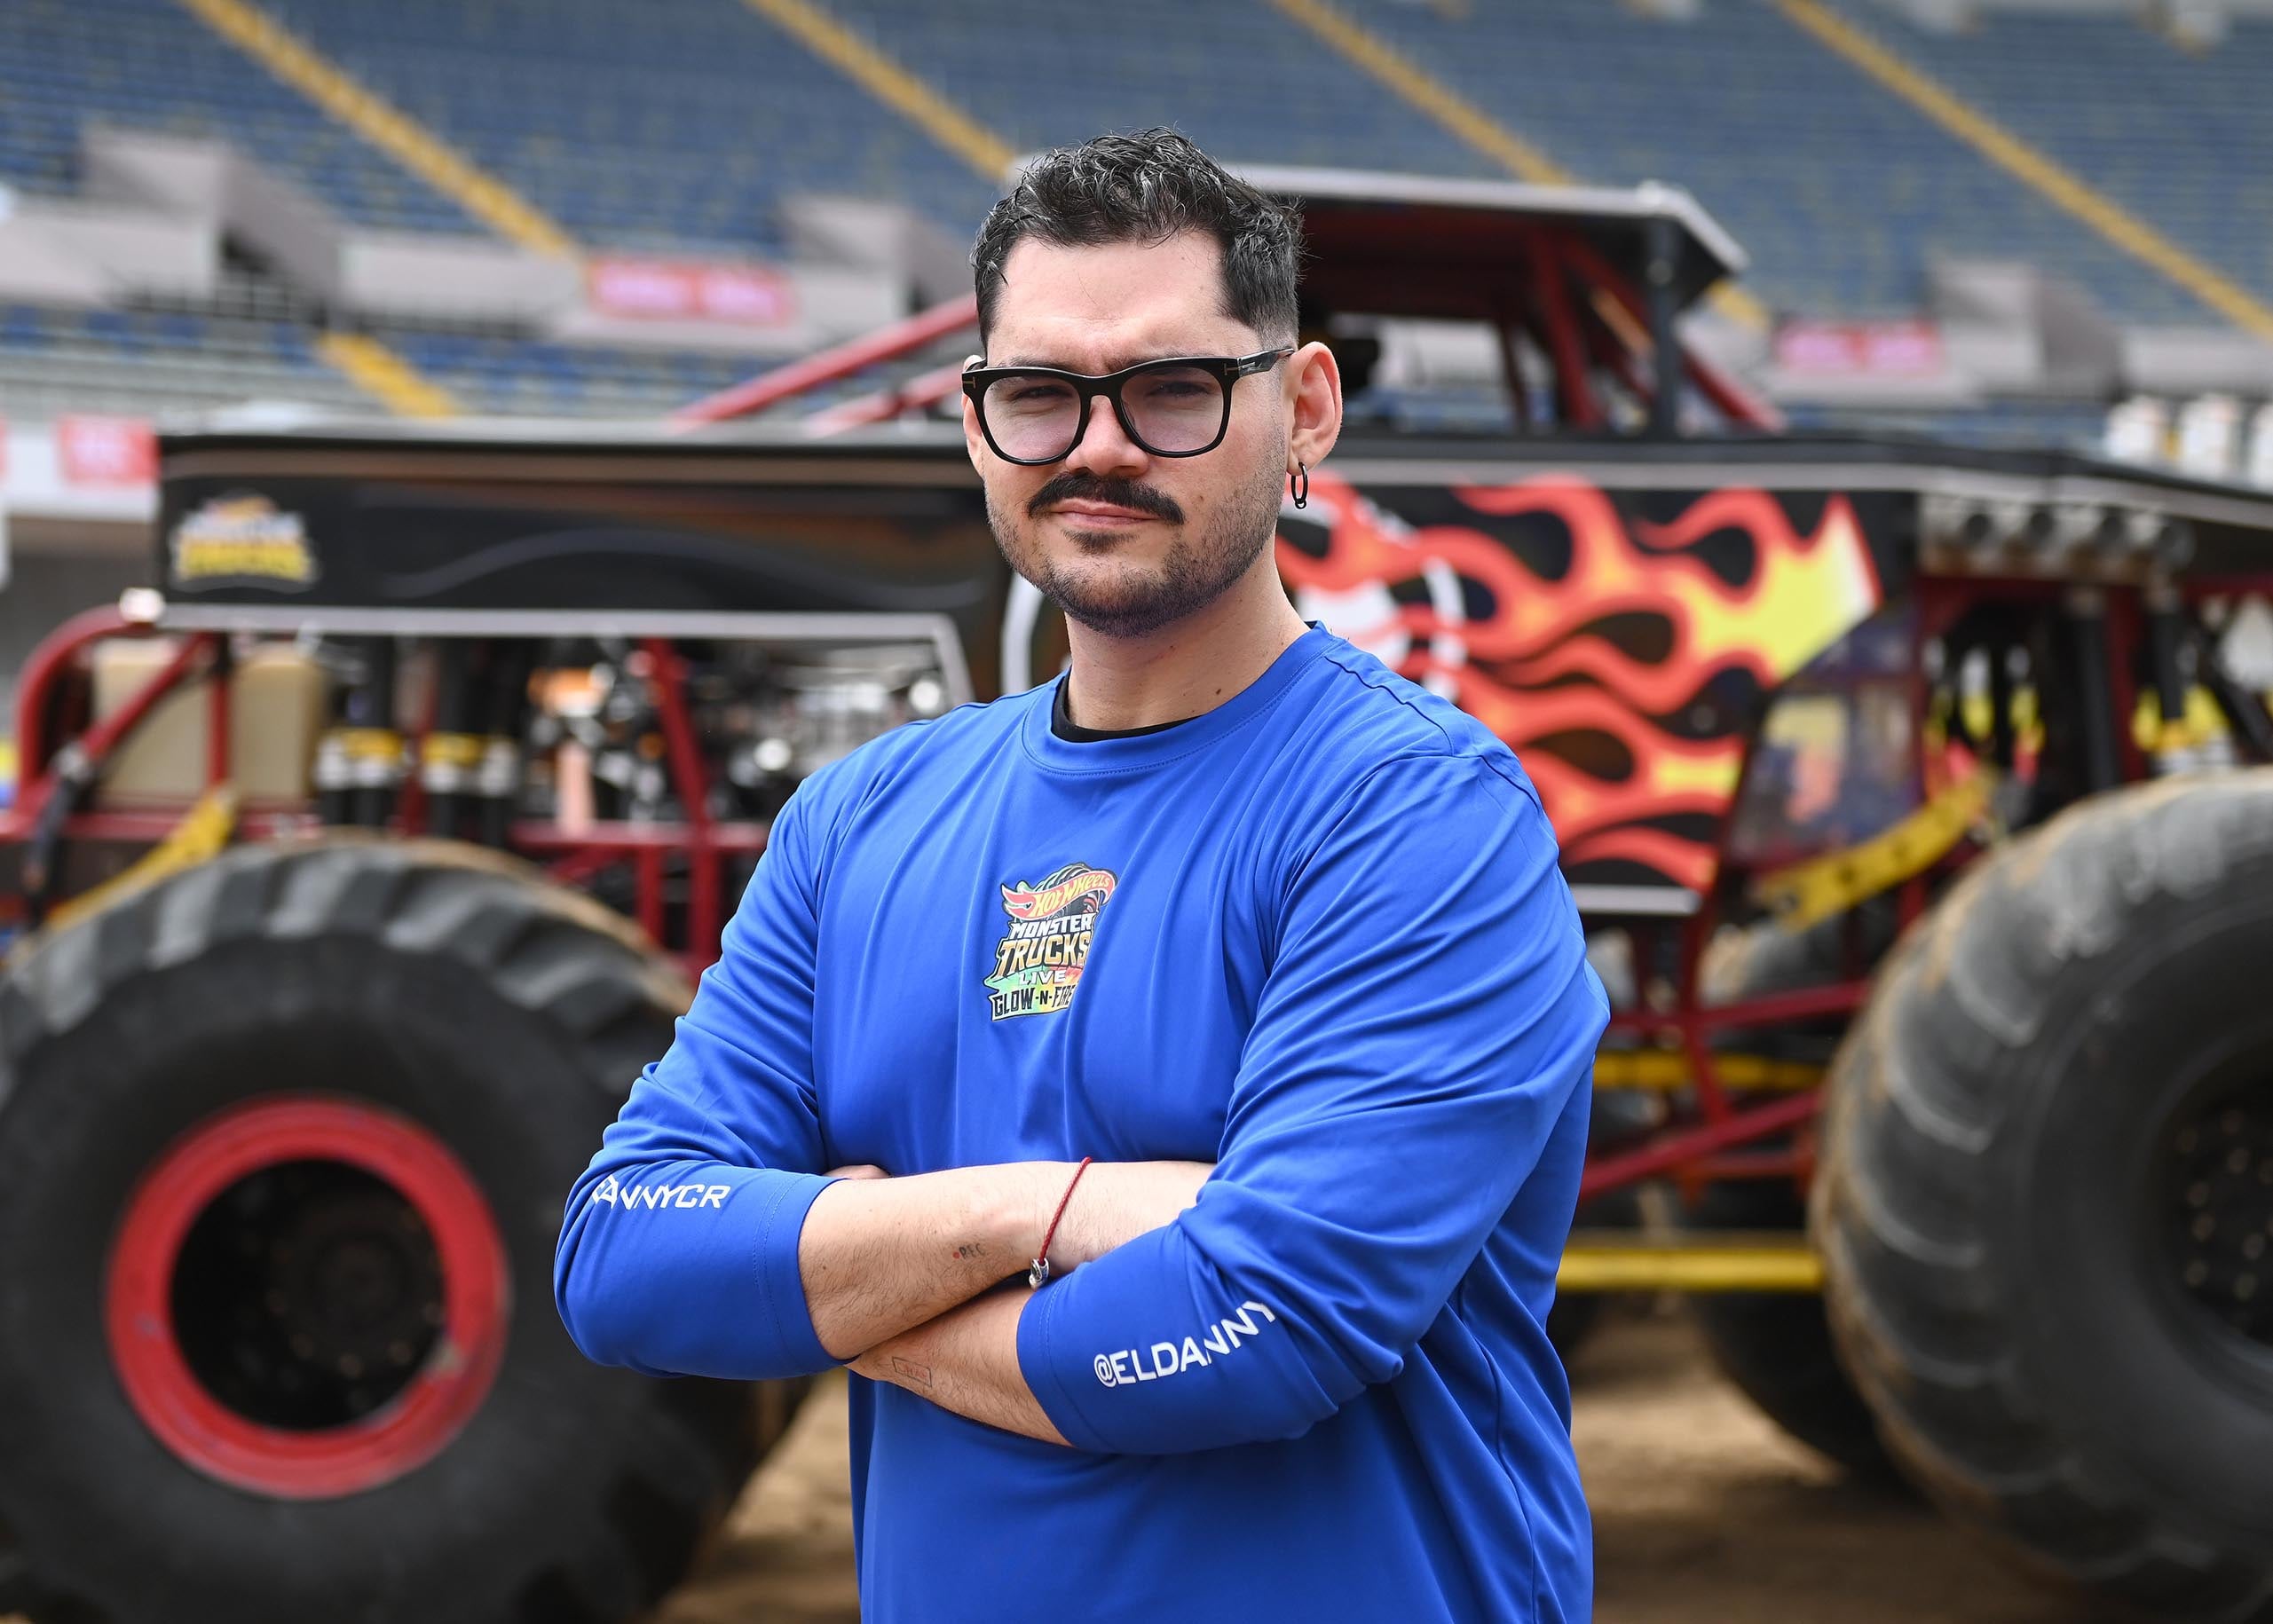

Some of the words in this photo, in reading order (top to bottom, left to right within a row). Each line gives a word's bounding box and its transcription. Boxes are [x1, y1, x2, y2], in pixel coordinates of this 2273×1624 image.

[1030, 891, 1064, 917] HOT
[1009, 912, 1096, 939] MONSTER
[996, 931, 1093, 978] TRUCKS
[1018, 968, 1067, 985] LIVE
[959, 1242, 985, 1260] REC
[1093, 1300, 1276, 1388] @ELDANNY
